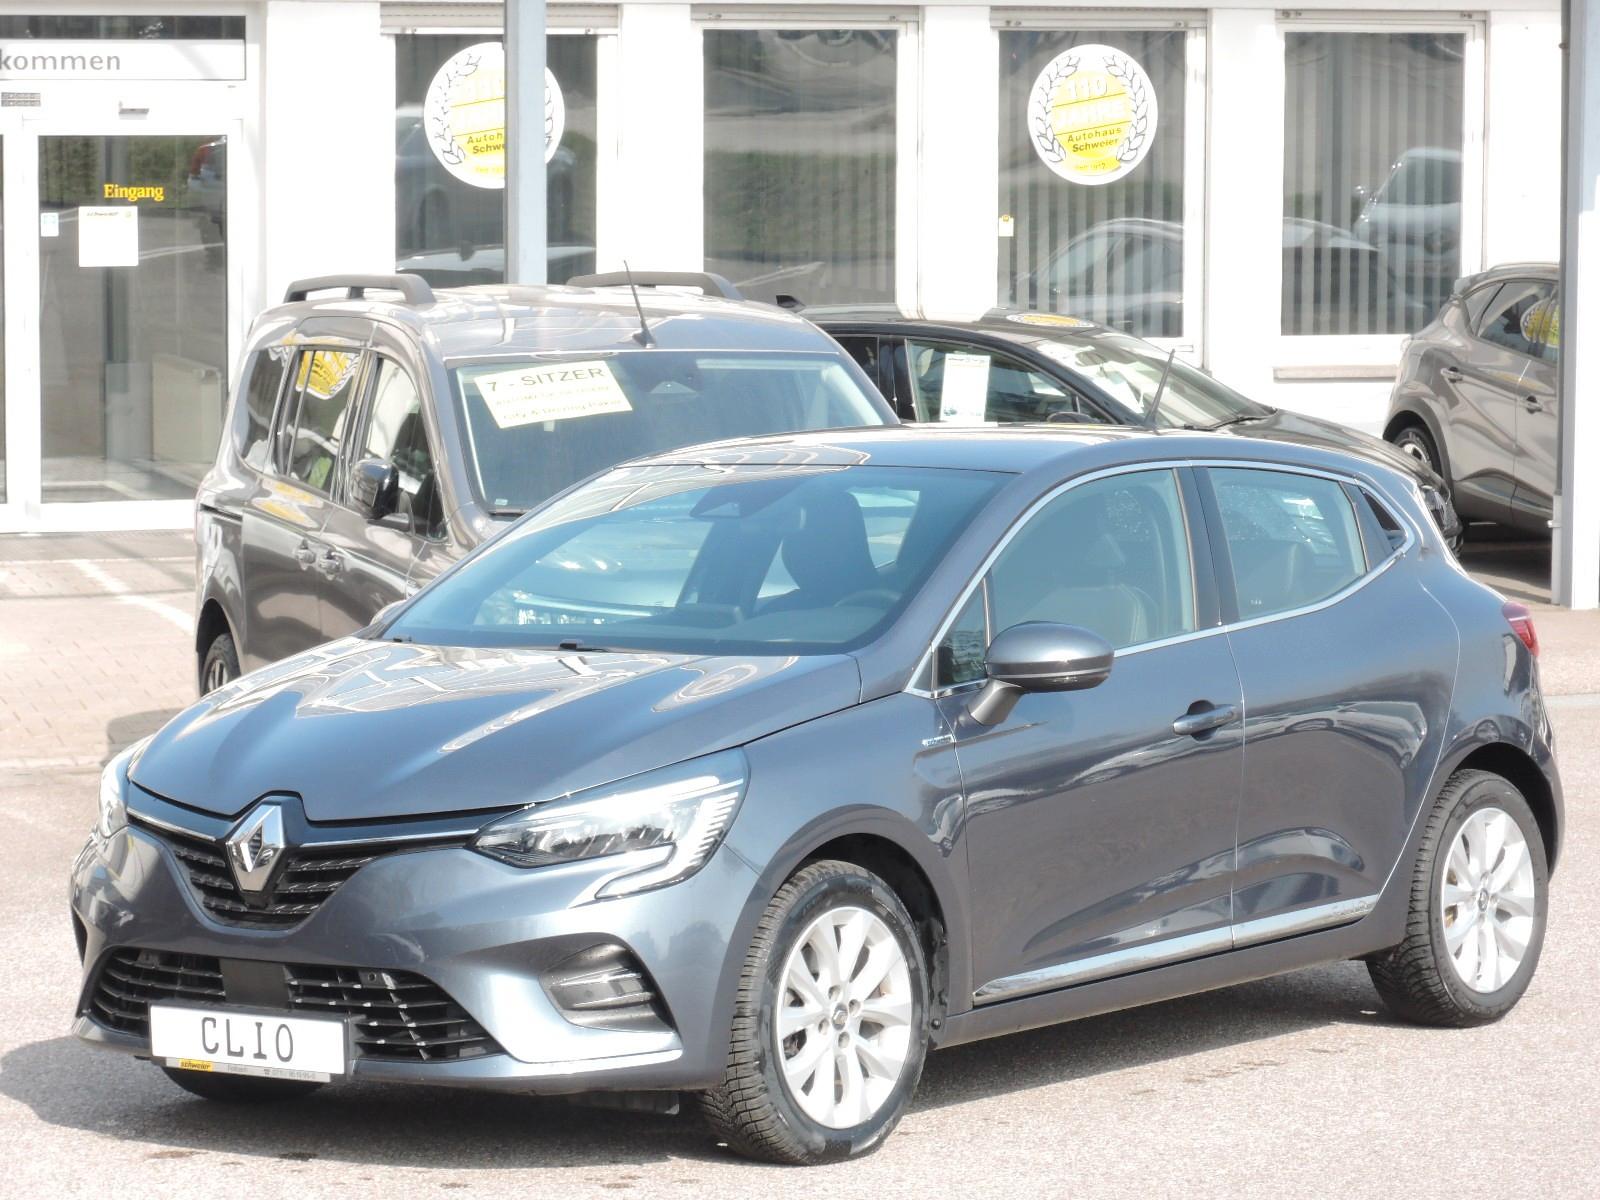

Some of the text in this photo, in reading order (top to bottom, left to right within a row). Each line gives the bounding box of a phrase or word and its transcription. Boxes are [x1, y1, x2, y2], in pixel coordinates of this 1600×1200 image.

[0, 48, 121, 71] kommen
[467, 132, 504, 145] Autoh
[1067, 127, 1122, 143] Autohaus
[472, 143, 506, 154] Schw
[1072, 138, 1119, 153] Schweier
[103, 183, 164, 202] Eingang
[487, 380, 498, 393] 7
[520, 367, 606, 387] SITZER
[201, 1016, 294, 1063] CLIO
